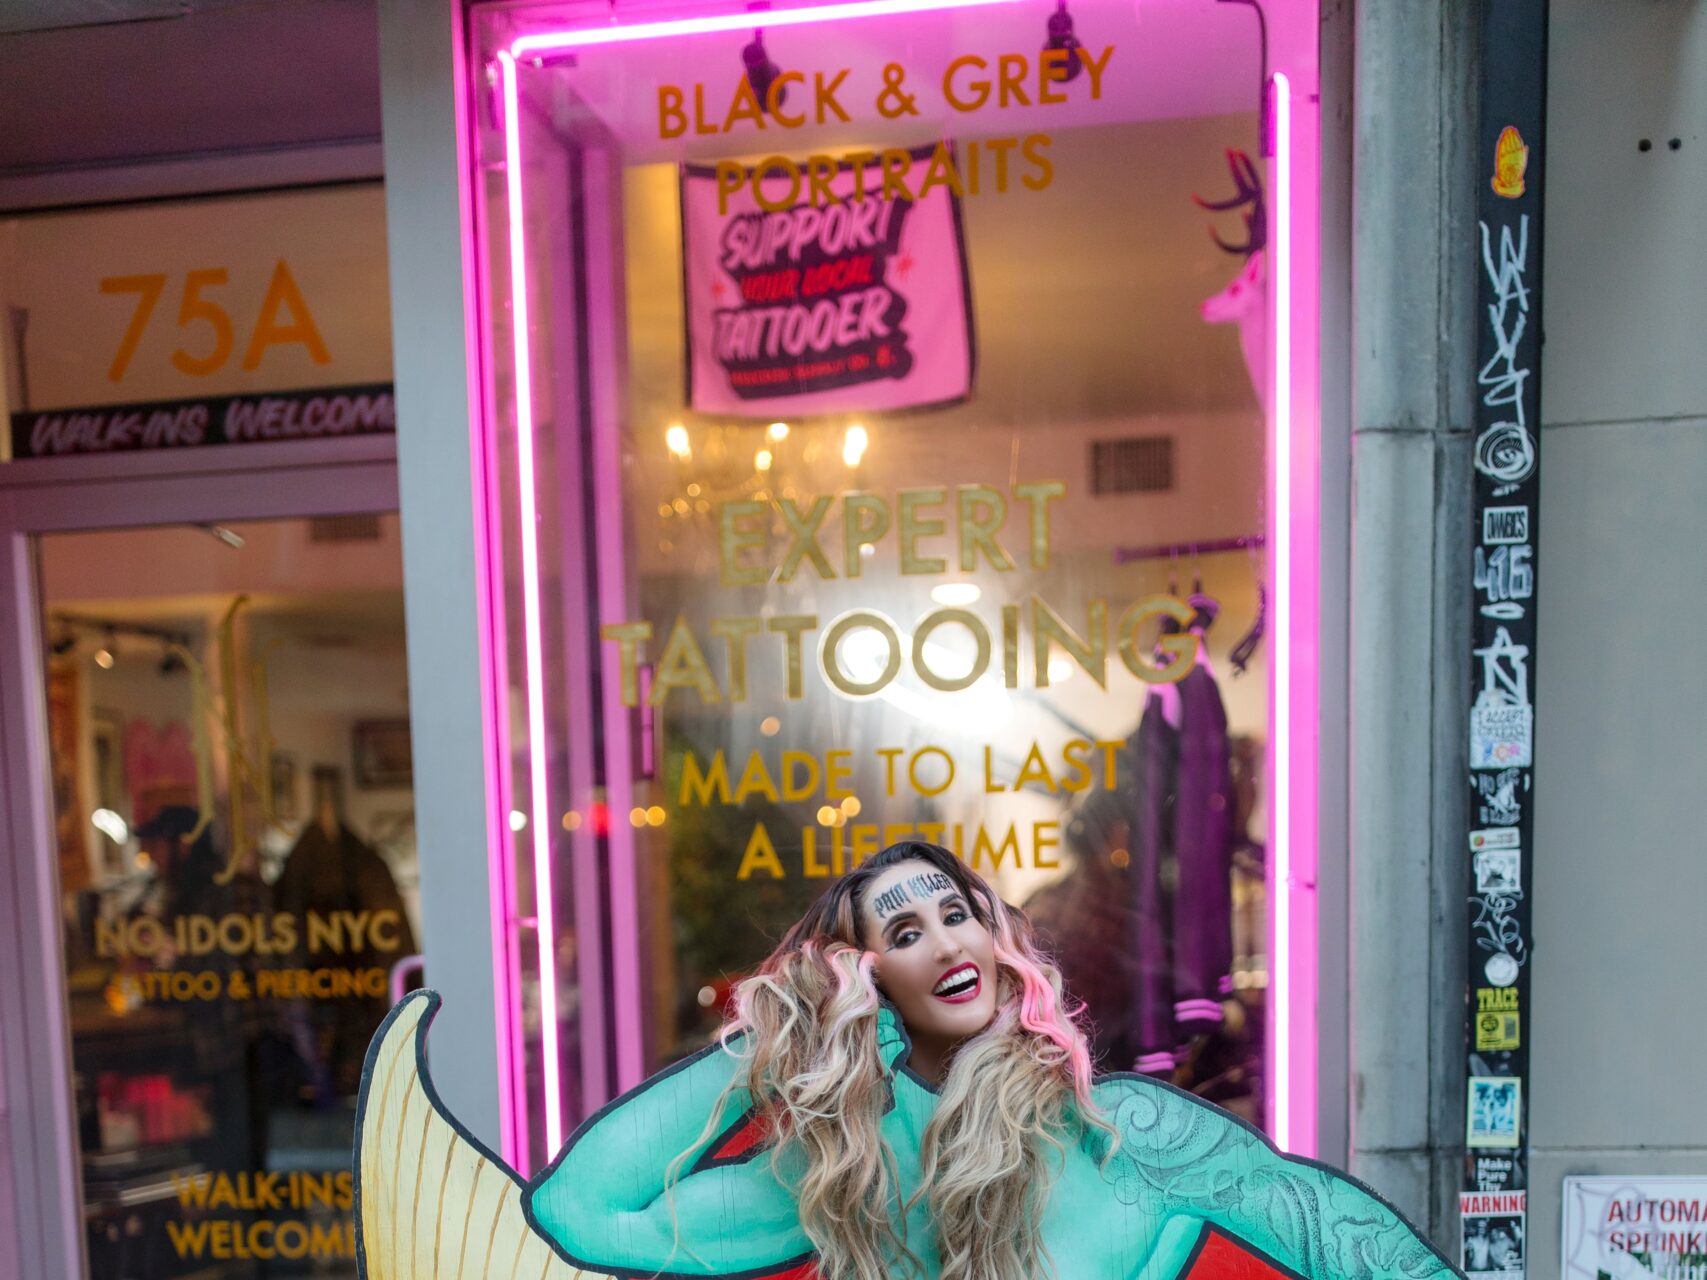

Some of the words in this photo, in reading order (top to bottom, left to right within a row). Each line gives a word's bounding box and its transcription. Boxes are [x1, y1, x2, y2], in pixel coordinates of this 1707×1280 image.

[657, 69, 852, 139] BLACK
[876, 62, 920, 118] &
[942, 45, 1116, 113] GREY
[716, 133, 1055, 217] PORTRAITS
[722, 196, 895, 270] SUPPORT
[101, 258, 333, 384] 75A
[716, 286, 893, 362] TATTOOER
[30, 403, 209, 454] WALK-INS
[224, 393, 395, 441] WELCOM
[717, 481, 1068, 587] EXPERT
[602, 592, 1201, 708] TATTOOING
[679, 748, 854, 807] MADE
[877, 746, 956, 797] TO
[983, 739, 1127, 794] LAST
[736, 822, 786, 881] A
[95, 913, 167, 958] NO
[174, 912, 297, 957] IDOLS
[306, 909, 400, 954] NYC
[255, 967, 388, 999] PIERCING
[1477, 987, 1519, 1010] TRACE
[170, 1170, 353, 1210] WALK-INS
[1478, 1157, 1512, 1171] Make
[1609, 1231, 1707, 1254] SPINK
